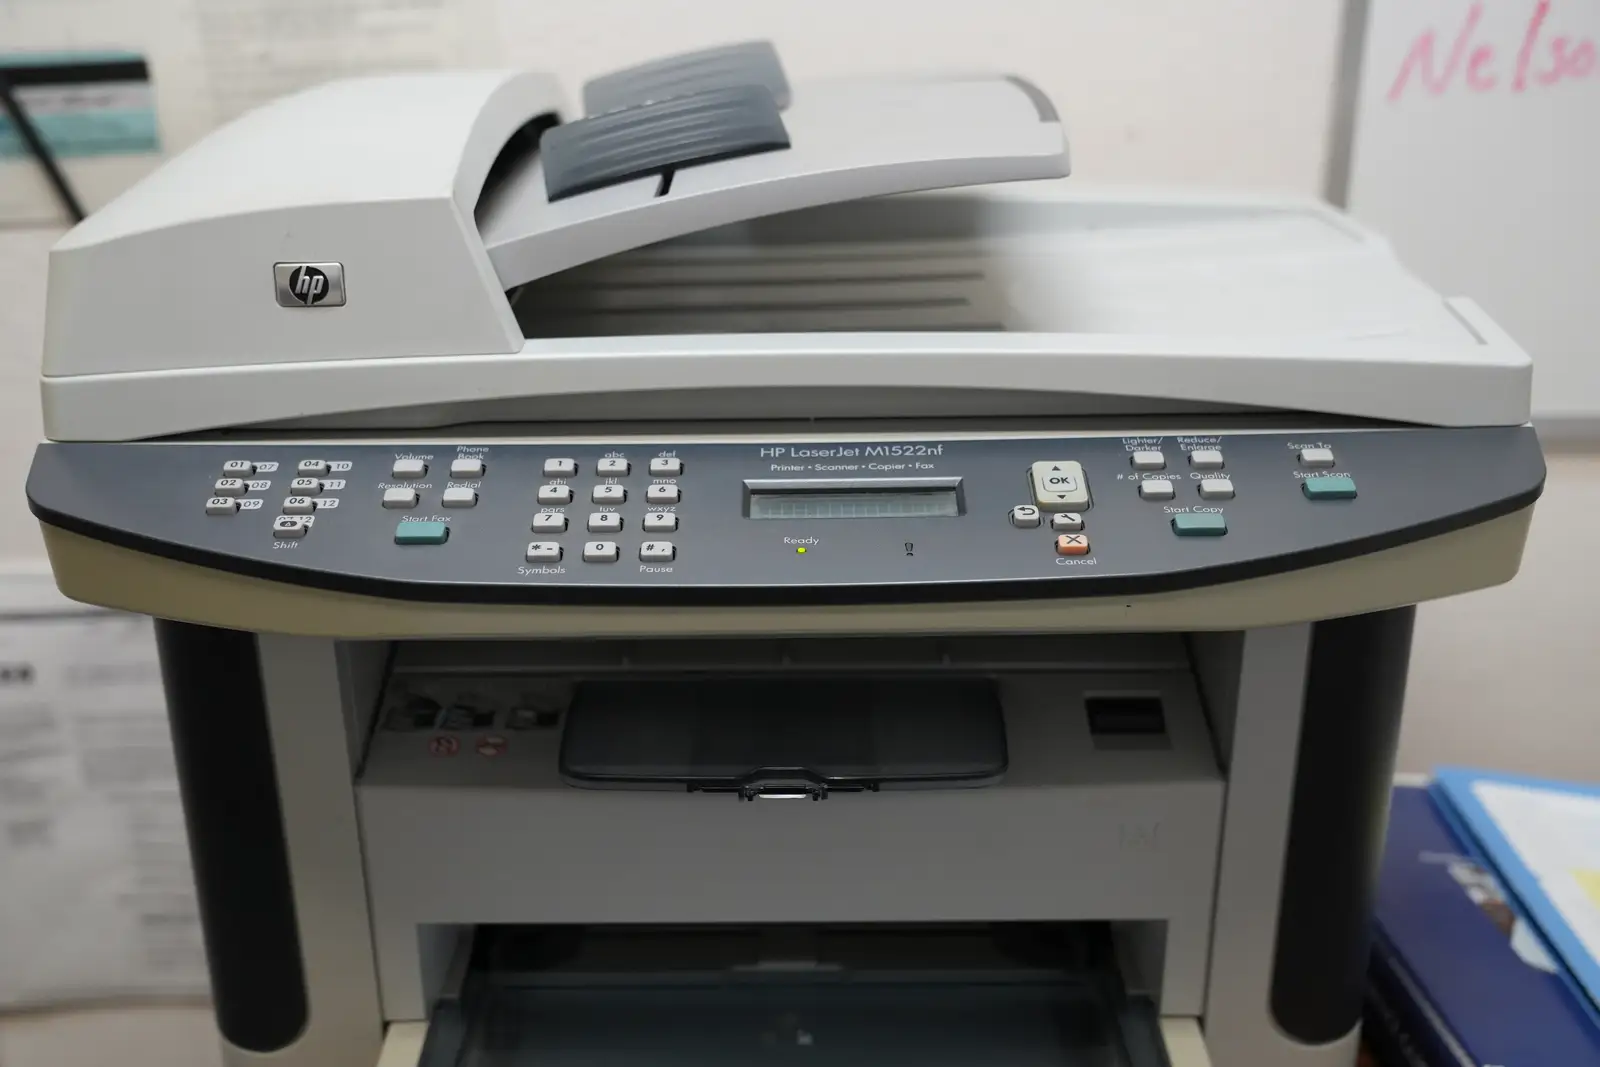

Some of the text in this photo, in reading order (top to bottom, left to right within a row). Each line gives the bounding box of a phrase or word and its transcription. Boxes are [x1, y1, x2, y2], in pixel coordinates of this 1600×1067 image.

[1122, 437, 1163, 446] Lighter/
[1177, 436, 1222, 445] Reduce/
[1180, 444, 1222, 452] Enlarge
[1287, 442, 1315, 450] Scan
[604, 450, 625, 458] abc
[658, 450, 676, 458] def
[760, 444, 944, 457] HP LaserJet M1522nf
[259, 463, 275, 471] 07
[304, 460, 320, 468] 04
[336, 462, 349, 470] 10
[814, 463, 859, 471] Scanner
[868, 462, 905, 471] Copier
[915, 462, 934, 470] Fax
[1128, 472, 1139, 480] of
[1142, 473, 1182, 481] Copies
[1190, 472, 1231, 481] Quality
[1293, 471, 1319, 479] Start
[251, 481, 268, 489] 08
[297, 478, 312, 486] 05
[446, 481, 481, 489] Redial
[1049, 477, 1070, 485] OK
[243, 500, 260, 508] 09
[289, 497, 305, 505] 06
[1193, 506, 1224, 514] Copy
[431, 514, 452, 522] Fax
[272, 541, 299, 549] Shift
[784, 537, 820, 546] Ready
[596, 543, 604, 551] 0
[1055, 558, 1097, 566] Cancel
[518, 566, 566, 575] Symbols
[640, 565, 673, 573] Pause
